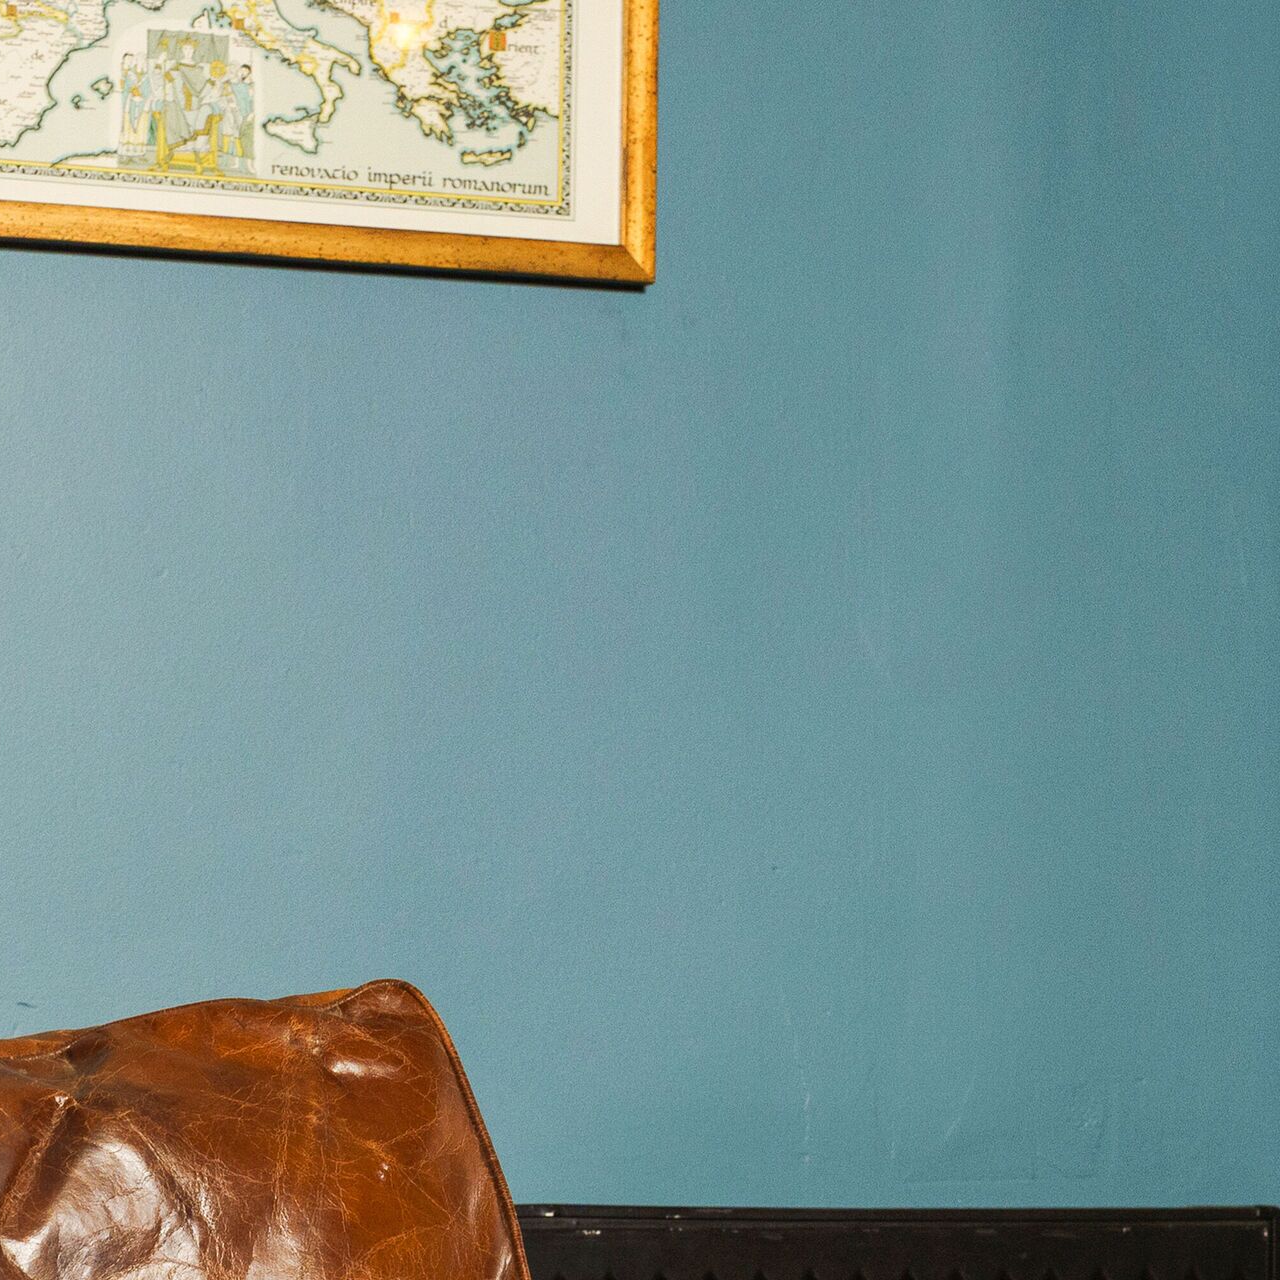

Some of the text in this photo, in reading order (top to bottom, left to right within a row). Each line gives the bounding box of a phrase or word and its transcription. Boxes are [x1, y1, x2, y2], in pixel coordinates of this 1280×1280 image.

[271, 163, 550, 196] renovatio imperii romanorum
